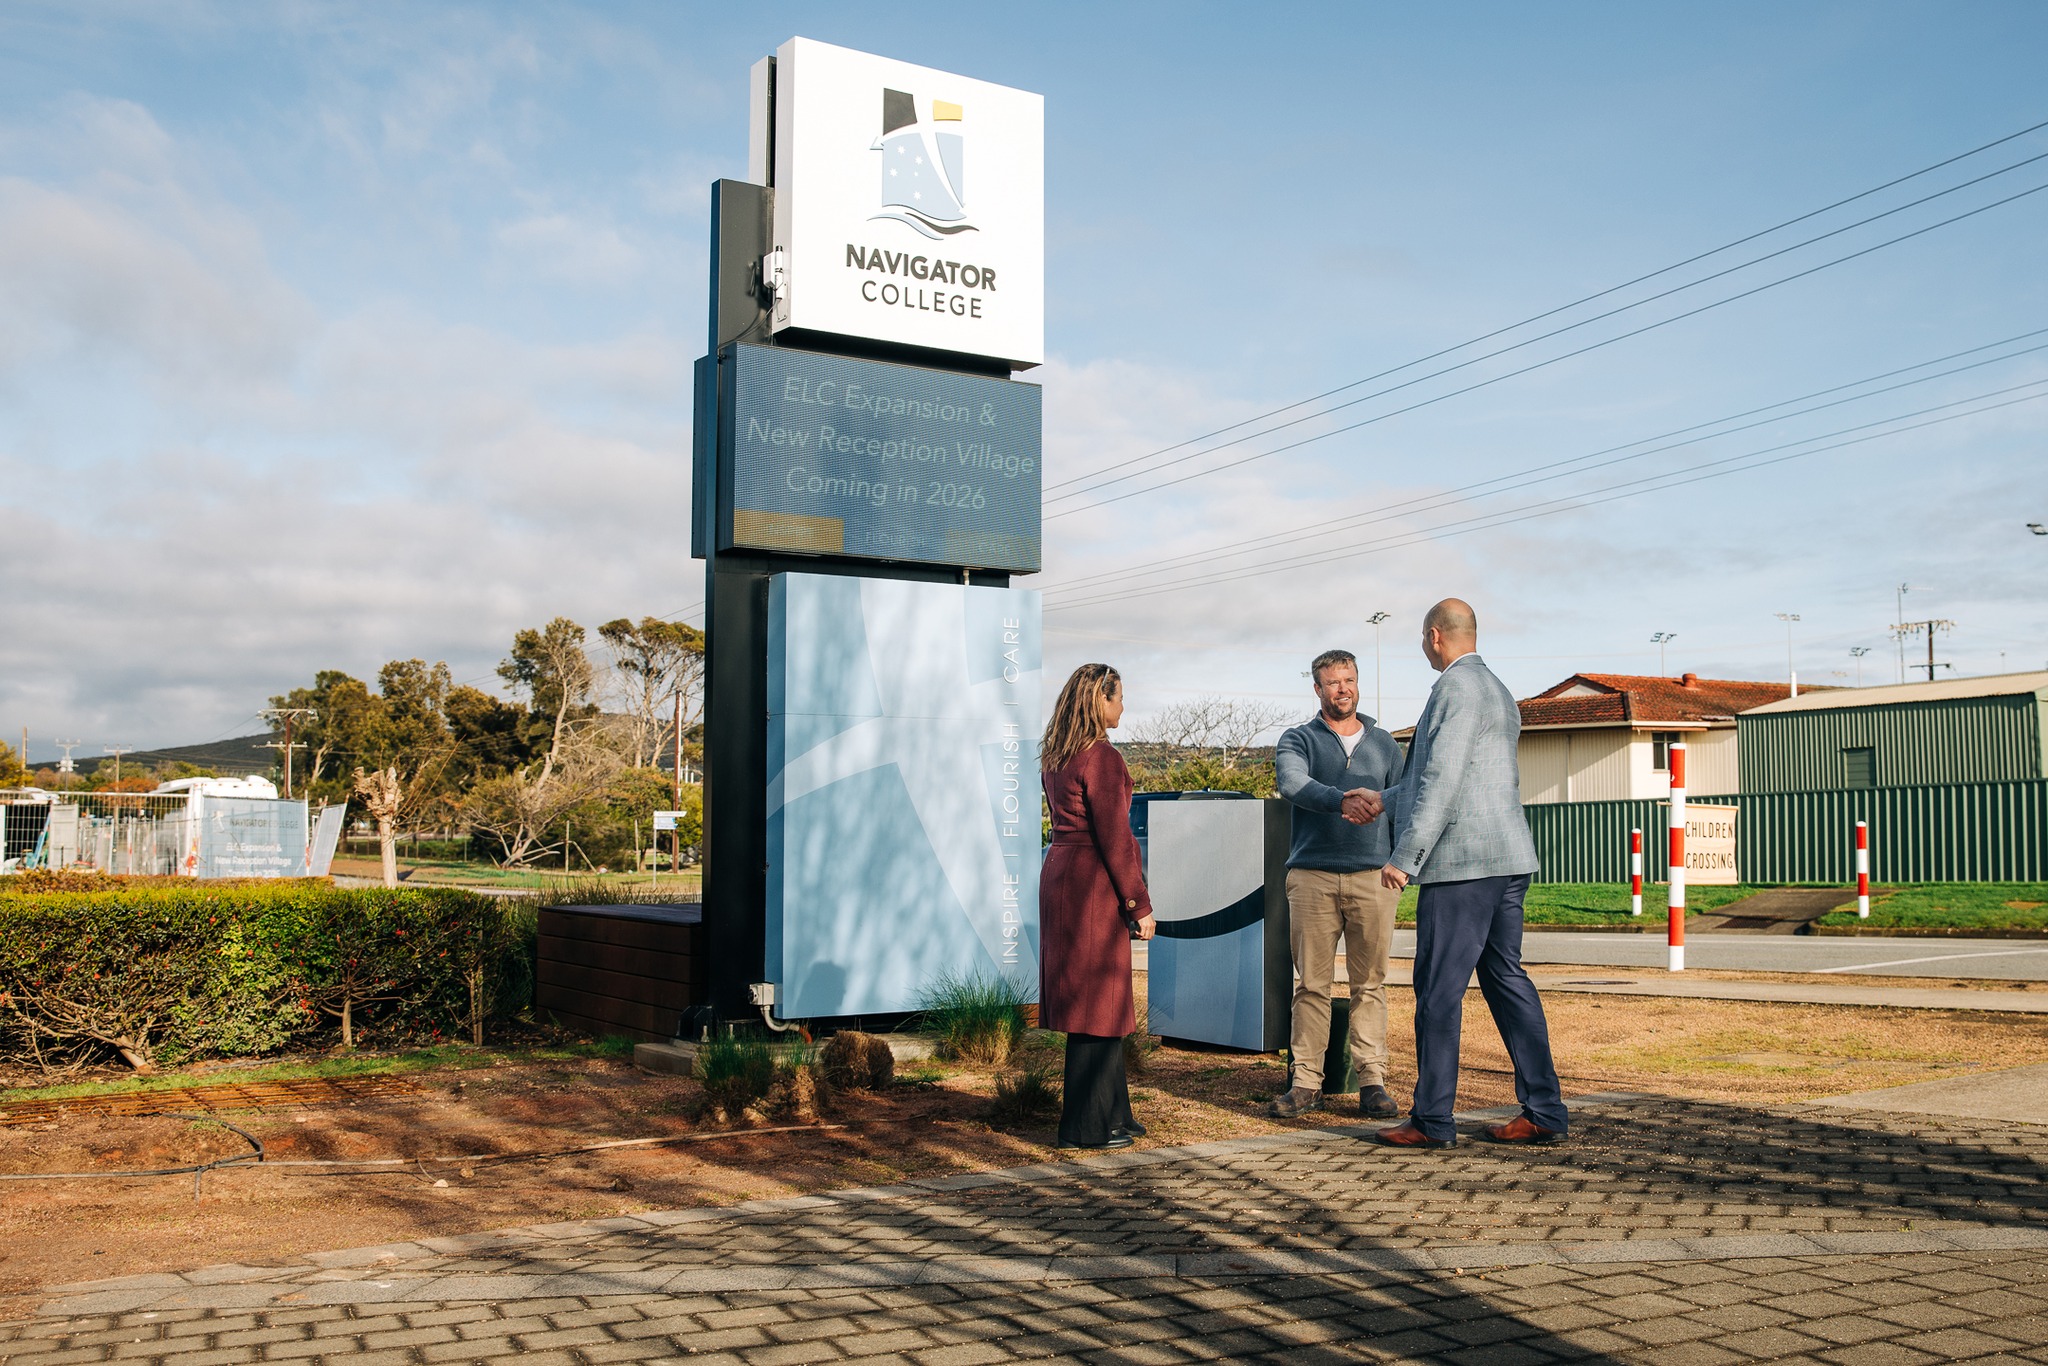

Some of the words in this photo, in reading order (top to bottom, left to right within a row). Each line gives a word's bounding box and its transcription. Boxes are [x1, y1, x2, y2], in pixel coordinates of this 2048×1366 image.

[846, 244, 996, 291] NAVIGATOR
[862, 280, 982, 319] COLLEGE
[783, 377, 834, 405] ELC
[845, 385, 970, 424] Expansion
[980, 403, 997, 426] &
[747, 417, 809, 447] New
[819, 426, 947, 464] Reception
[957, 442, 1035, 478] Village
[786, 467, 887, 506] Coming
[897, 479, 917, 503] in
[927, 481, 985, 510] 2026
[1003, 616, 1020, 683] CARE
[1003, 723, 1019, 838] FLOURISH
[1685, 821, 1733, 838] CHILDREN
[215, 856, 231, 865] New
[233, 856, 266, 866] Reception
[268, 856, 292, 867] Village
[1685, 852, 1733, 869] CROSSING
[1003, 873, 1019, 965] INSPIRE
